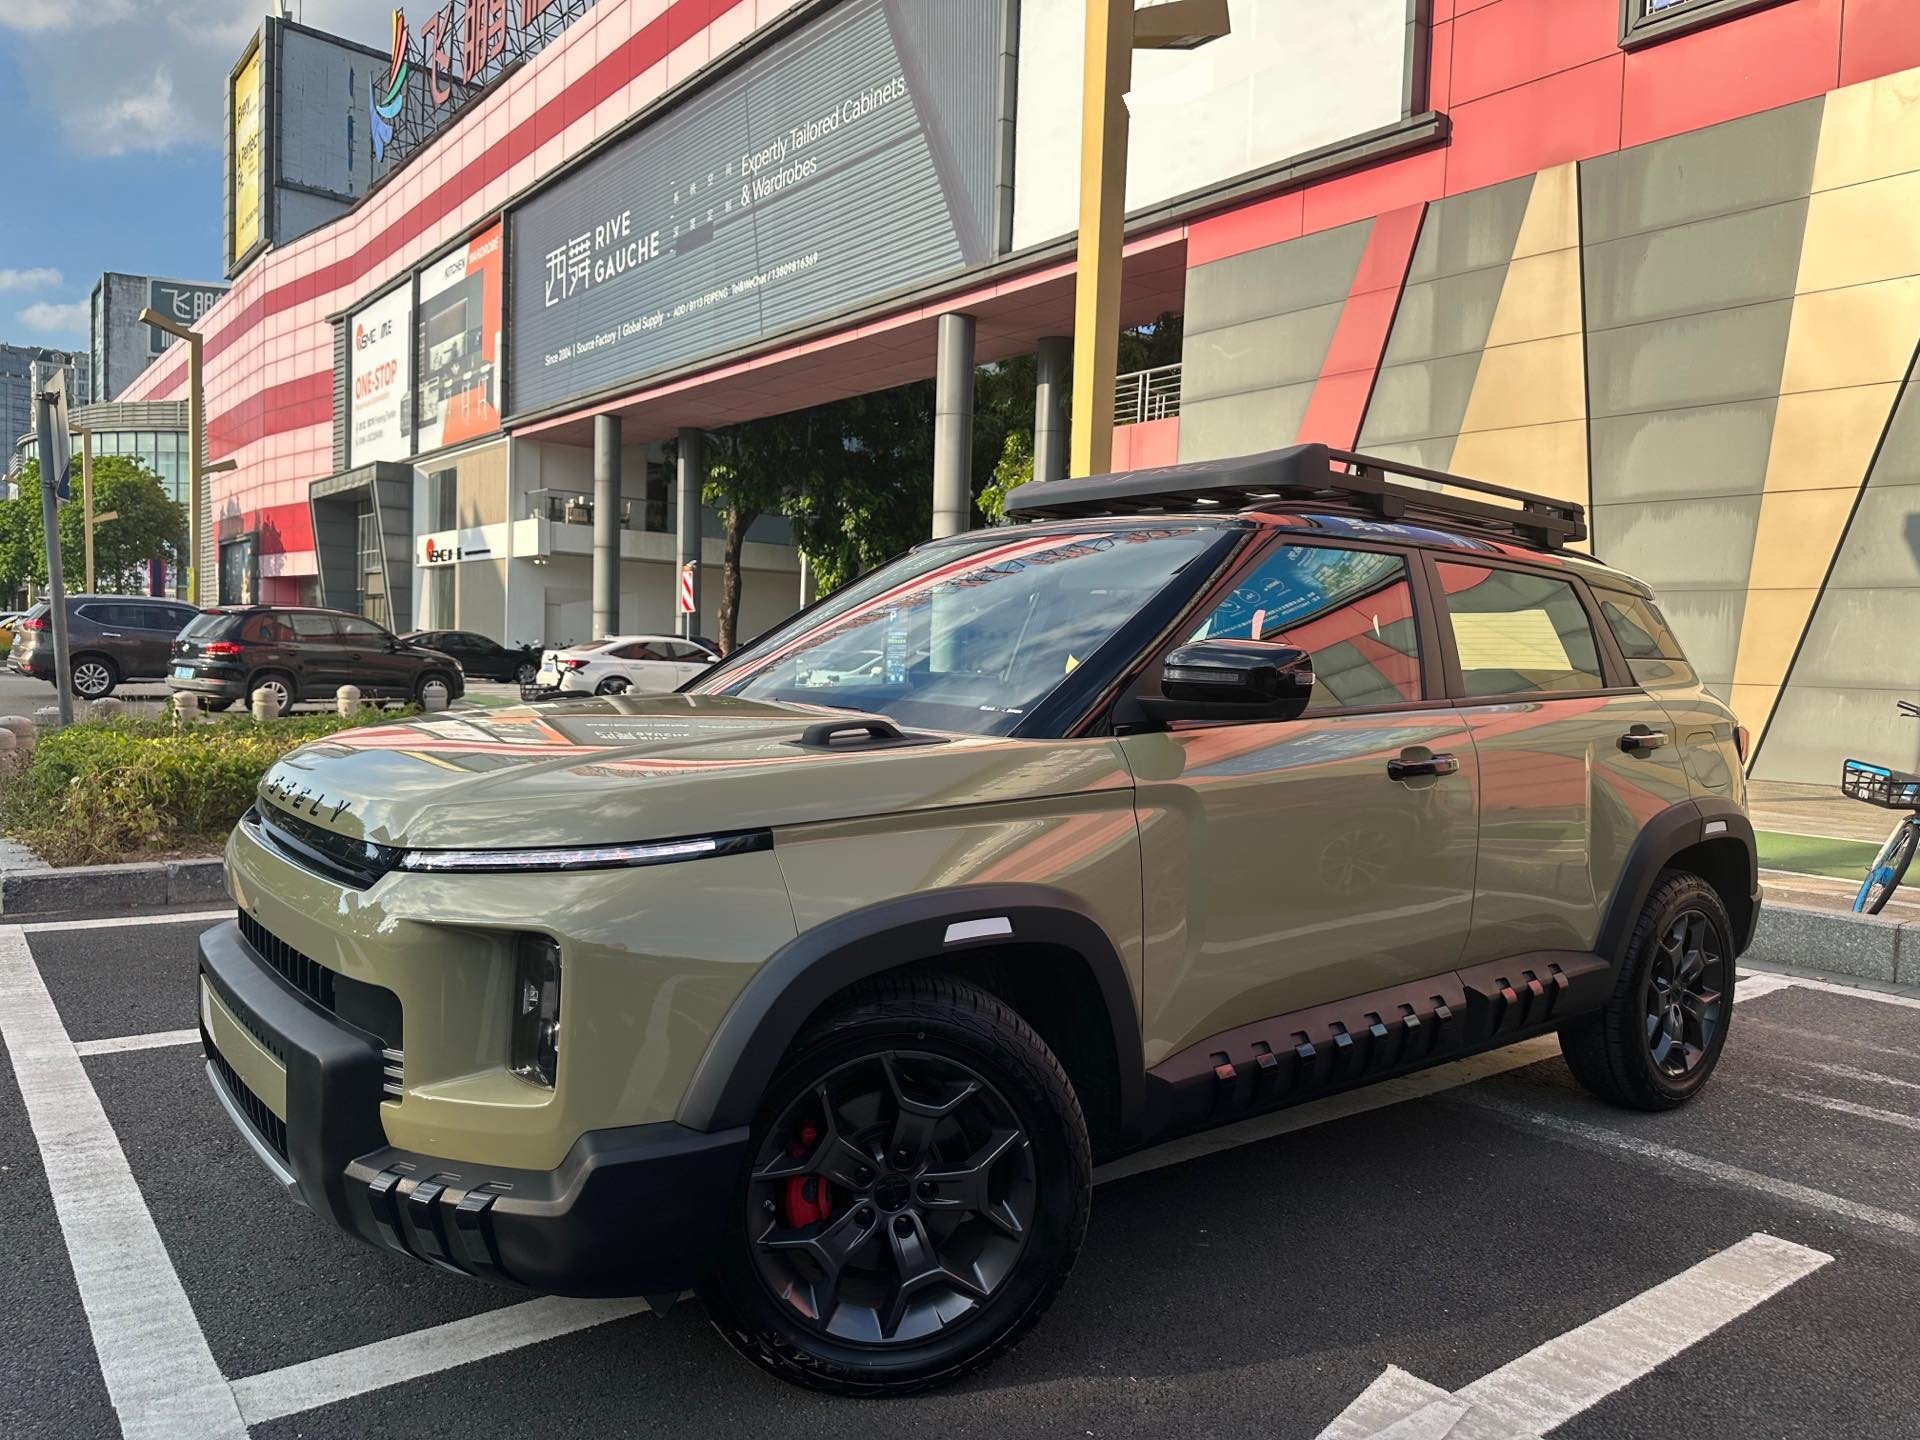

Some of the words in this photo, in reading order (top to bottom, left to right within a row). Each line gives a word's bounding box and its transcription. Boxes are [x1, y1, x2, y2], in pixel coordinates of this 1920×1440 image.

[741, 136, 789, 177] Expertly
[790, 105, 839, 151] Tailored
[842, 76, 905, 124] Cabinets
[740, 184, 751, 206] &
[752, 156, 817, 201] Wardrobes
[595, 210, 631, 250] RIVE
[594, 230, 660, 283] GAUCHE
[544, 353, 559, 366] Since
[559, 346, 572, 361] 2004
[576, 340, 595, 354] Source
[595, 331, 617, 347] Factory
[622, 318, 642, 336] Global
[642, 310, 664, 330] Supply
[355, 360, 397, 400] ONE-STOP
[268, 775, 352, 823] GEELY
